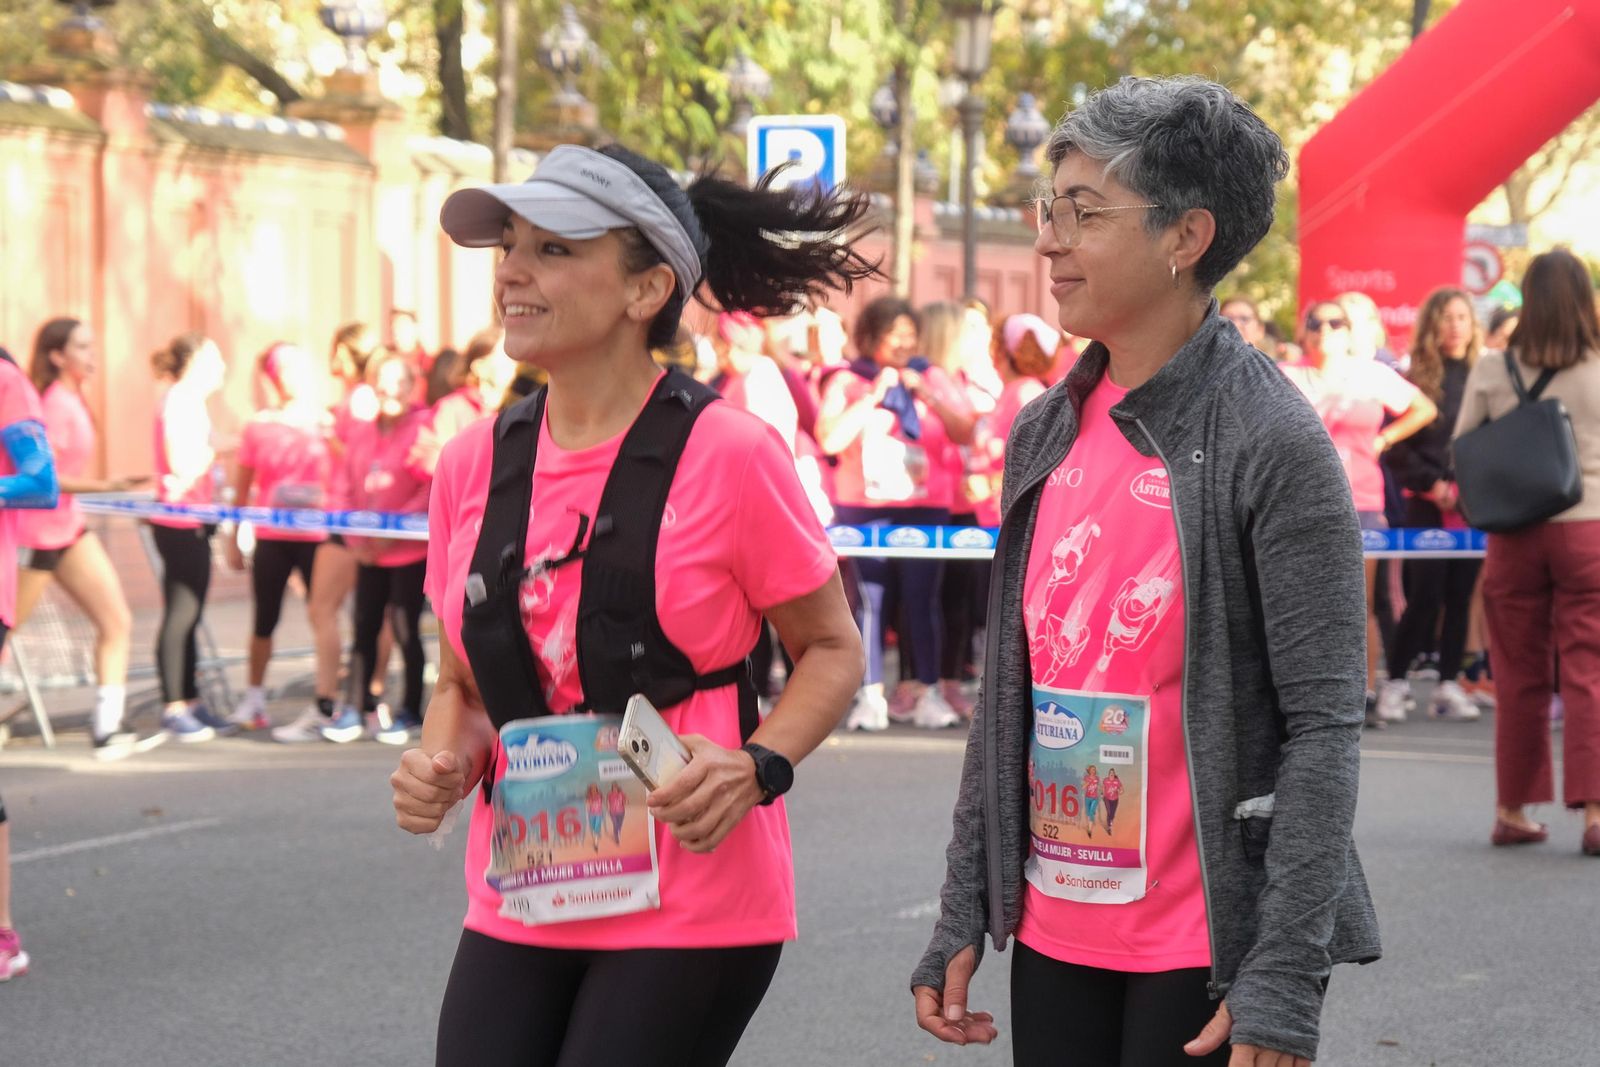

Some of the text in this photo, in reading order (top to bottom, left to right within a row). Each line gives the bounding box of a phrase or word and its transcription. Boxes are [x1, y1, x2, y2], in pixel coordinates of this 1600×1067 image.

[766, 129, 825, 192] P
[1326, 265, 1396, 291] Sports
[1103, 708, 1125, 725] 20
[1042, 823, 1059, 839] 522
[1049, 844, 1072, 858] MUJER
[1077, 849, 1114, 862] SEVILLA
[541, 864, 574, 882] MUJER
[583, 858, 623, 877] SEVILLA
[1066, 874, 1122, 890] Santander
[568, 887, 633, 905] Santander
